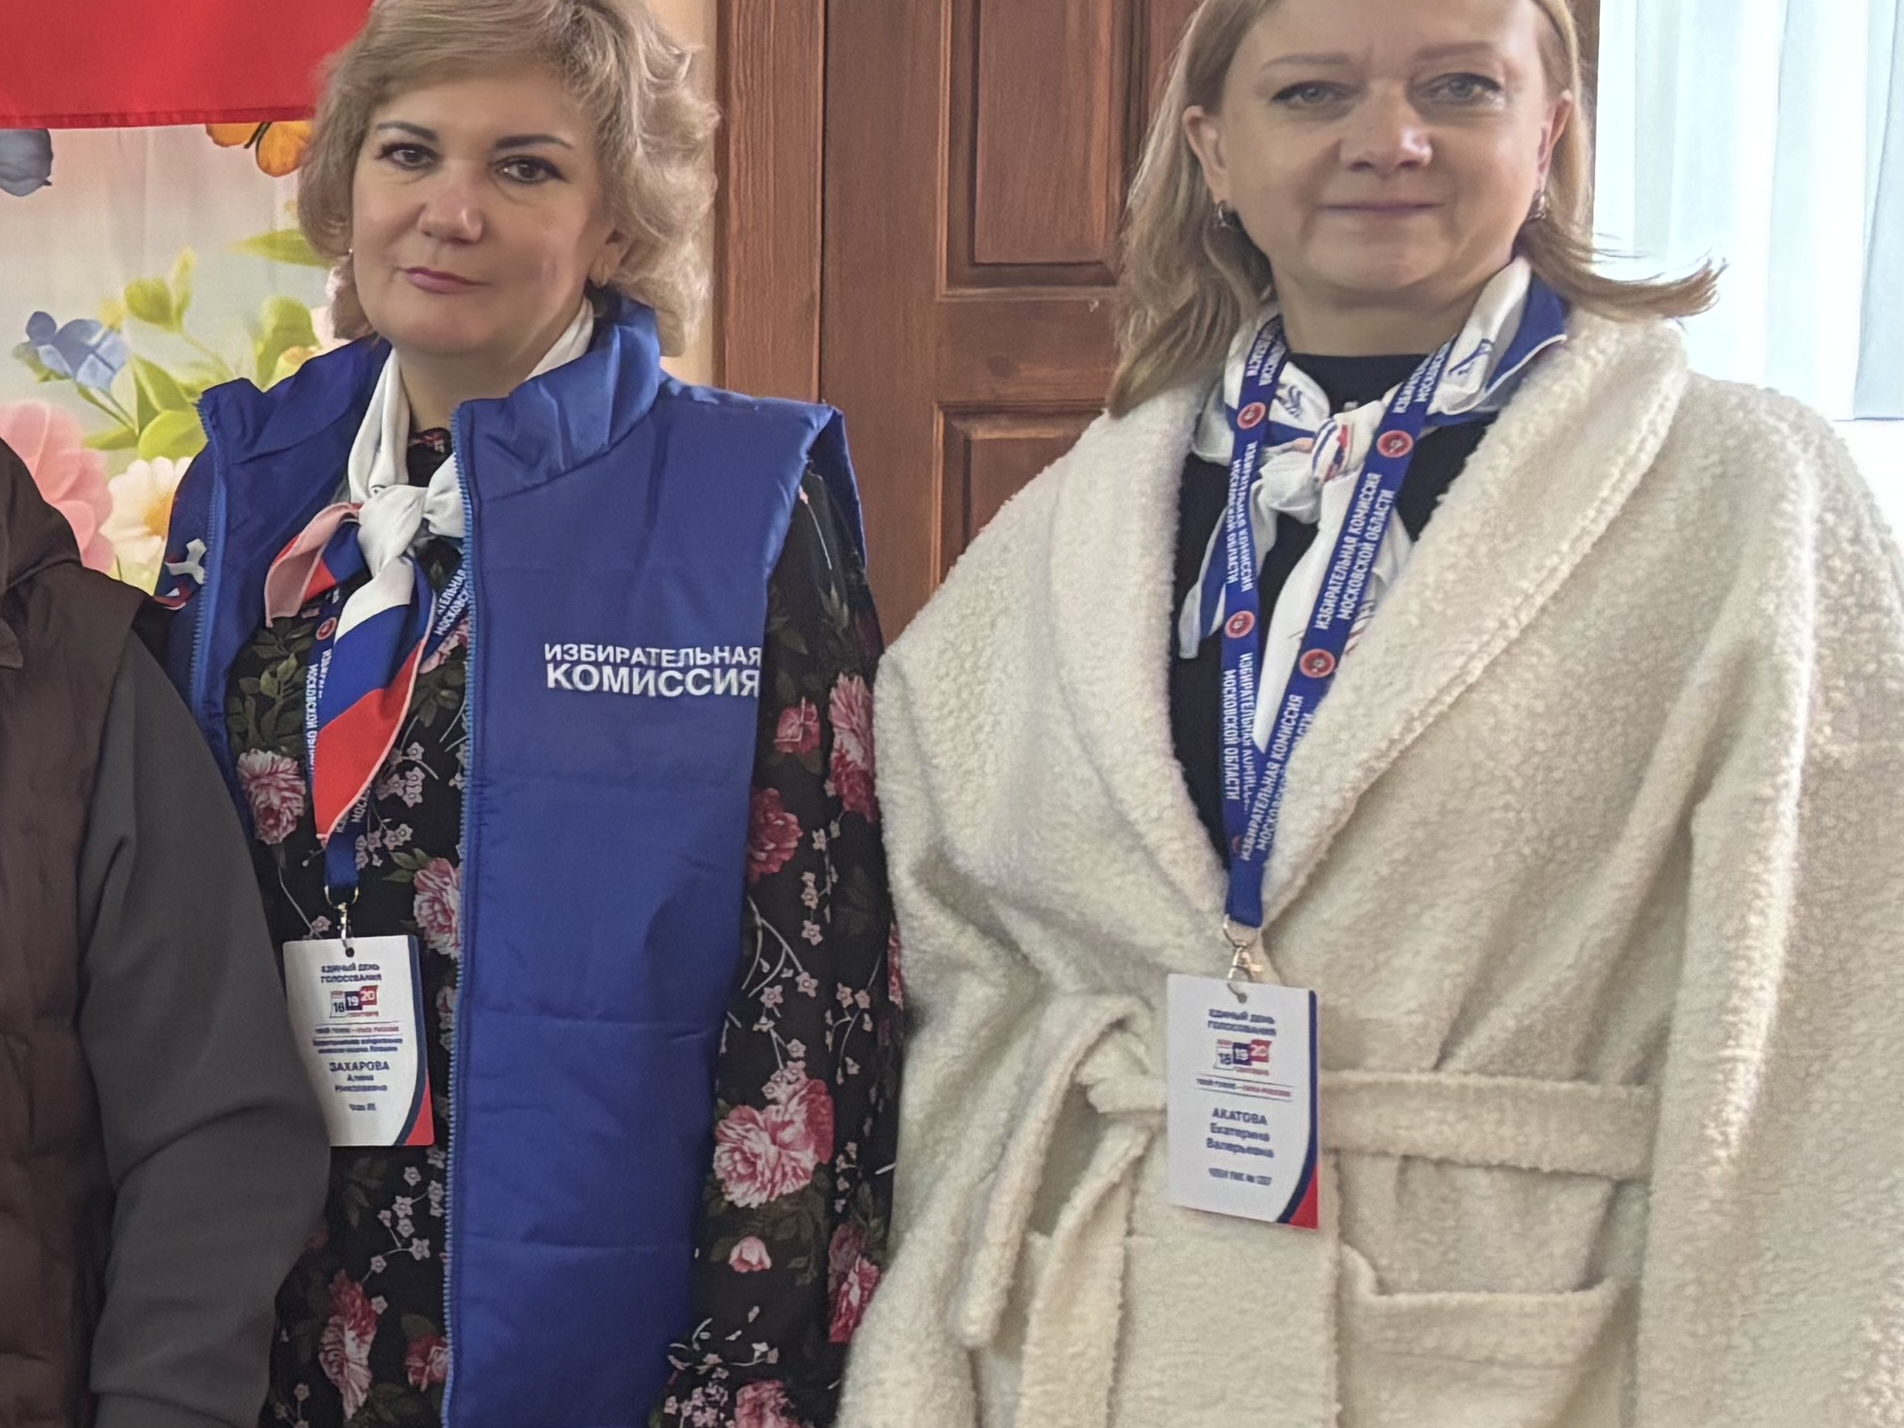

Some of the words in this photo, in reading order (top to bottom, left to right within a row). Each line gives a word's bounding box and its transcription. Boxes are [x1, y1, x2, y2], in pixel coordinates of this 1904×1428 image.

[1314, 539, 1358, 631] ИЗБИРАТЕЛЬНАЯ
[1348, 472, 1382, 535] КОМИССИЯ
[1337, 542, 1376, 621] МОСКОВСКОЙ
[1364, 489, 1395, 543] ОБЛАСТИ
[544, 643, 762, 667] ИЗБИРАТЕЛЬНАЯ
[546, 663, 760, 698] КОМИССИЯ
[1223, 669, 1241, 745] МОСКОВСКОЙ
[1224, 747, 1240, 801] ОБЛАСТИ
[1241, 761, 1281, 860] ИЗБИРАТЕЛЬНАЯ
[1270, 694, 1304, 761] КОМИССИЯ
[329, 1061, 390, 1072] ЗАХАРОВА
[1212, 1107, 1268, 1125] АКАТОВА
